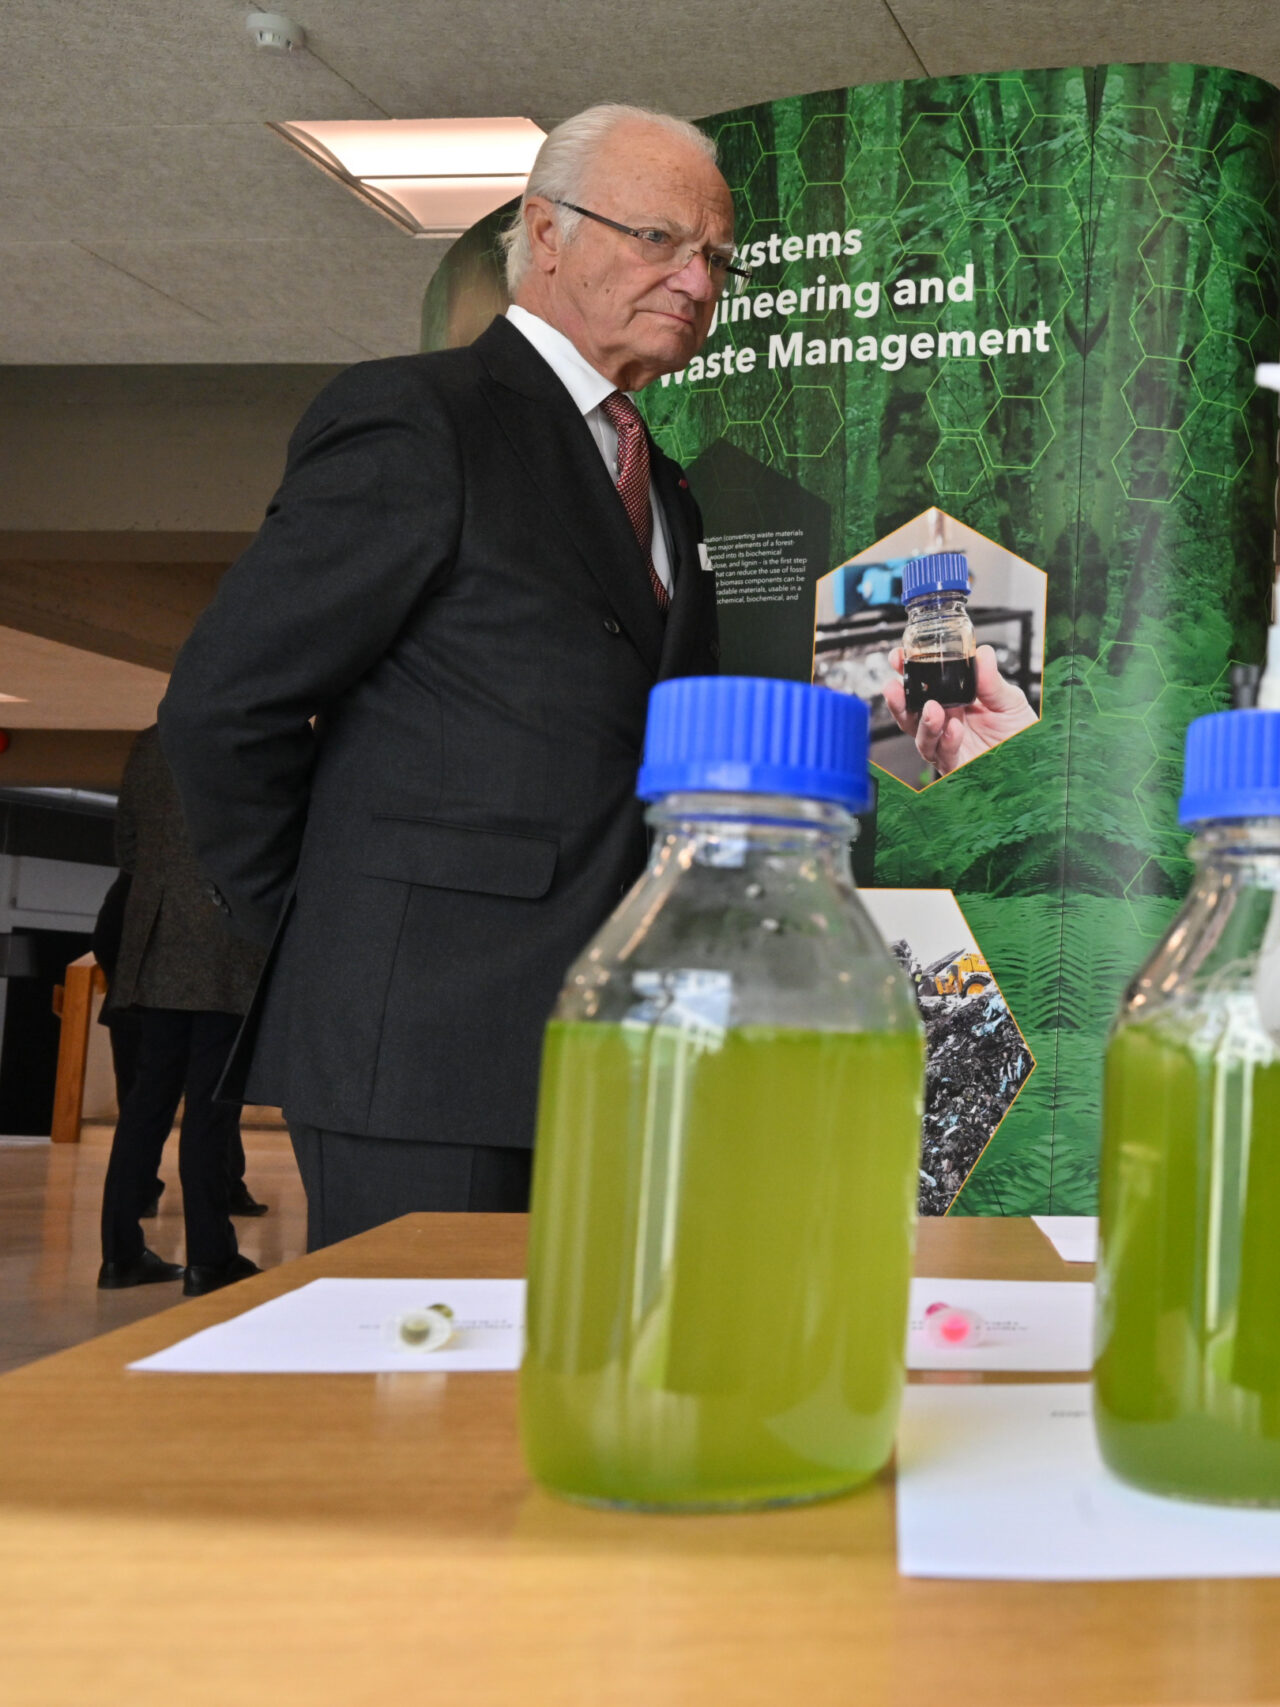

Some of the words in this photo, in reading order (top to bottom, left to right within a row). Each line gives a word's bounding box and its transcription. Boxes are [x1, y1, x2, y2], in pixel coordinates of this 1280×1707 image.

[733, 228, 862, 280] ystems
[707, 275, 880, 335] ineering
[894, 264, 974, 305] and
[768, 320, 1050, 371] Management
[746, 548, 782, 557] biochemical
[745, 576, 782, 585] components
[747, 594, 784, 602] biochemical,
